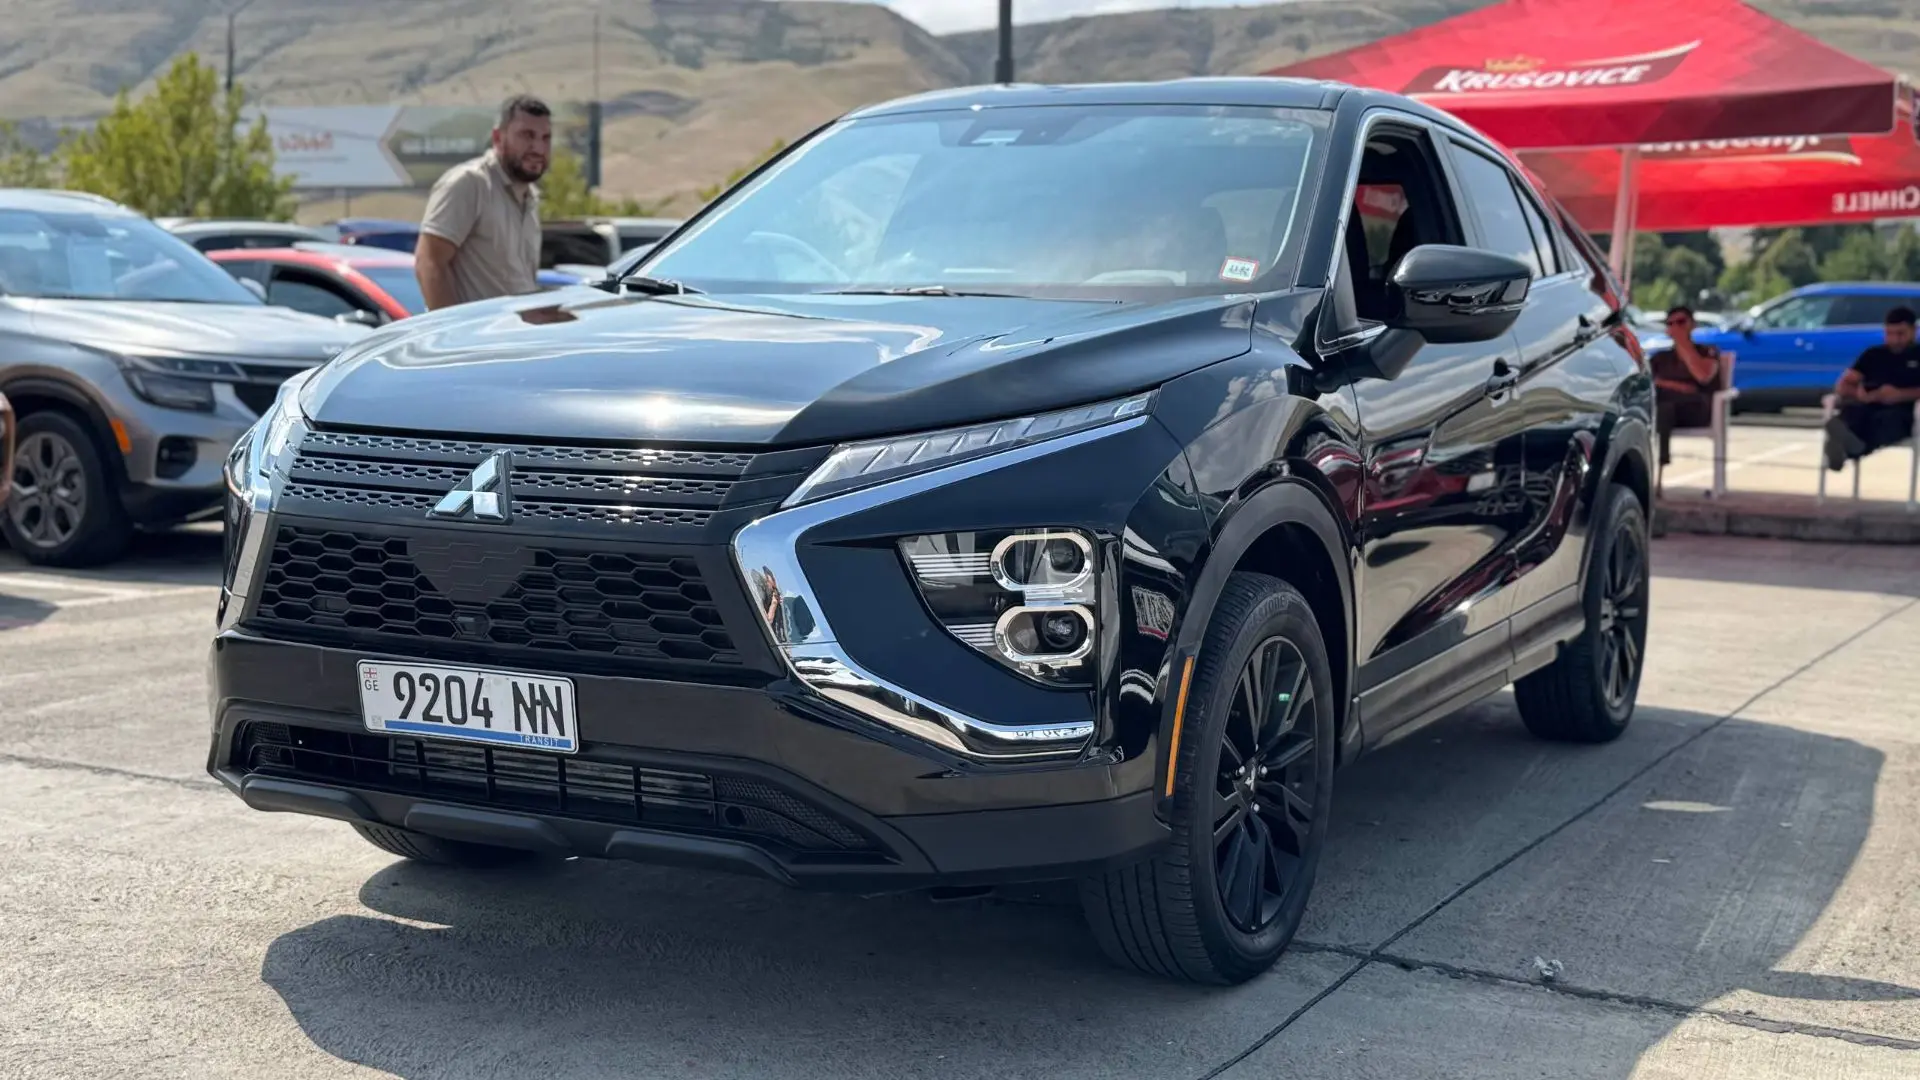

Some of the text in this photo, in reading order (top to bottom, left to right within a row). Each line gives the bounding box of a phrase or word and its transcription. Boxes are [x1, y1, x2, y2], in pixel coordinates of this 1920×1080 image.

[364, 679, 380, 691] GE
[393, 671, 566, 736] 9204 NN
[519, 734, 559, 747] TRANSIT
